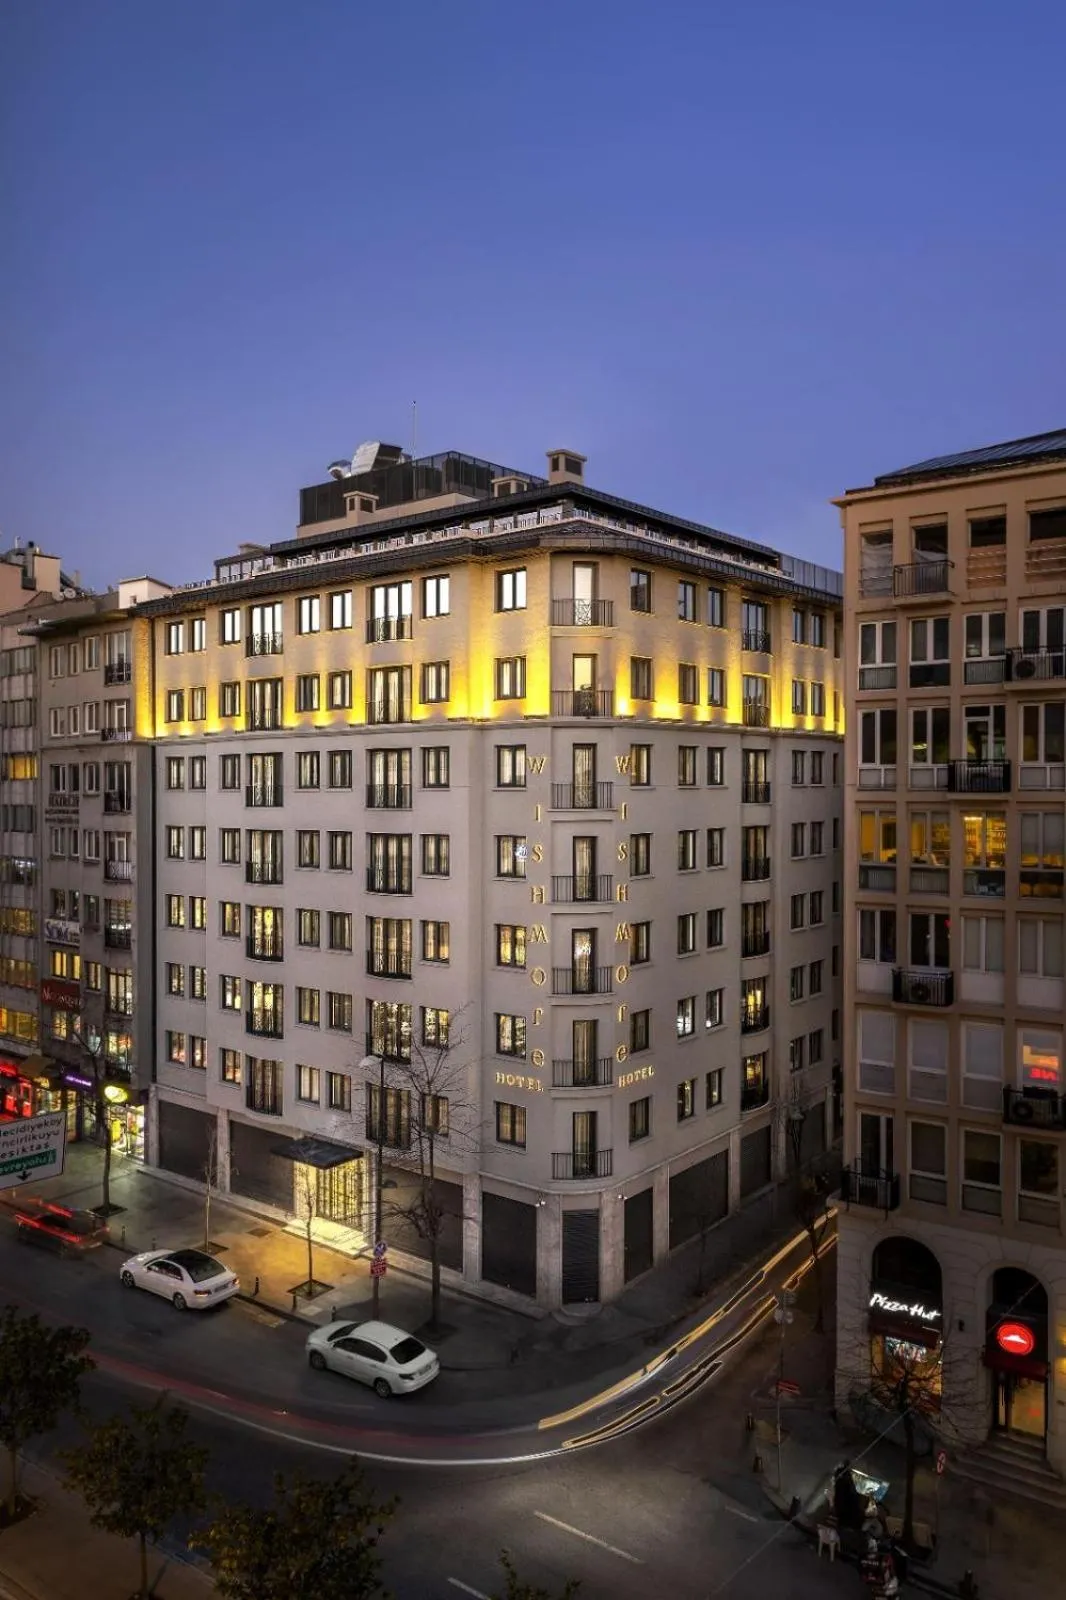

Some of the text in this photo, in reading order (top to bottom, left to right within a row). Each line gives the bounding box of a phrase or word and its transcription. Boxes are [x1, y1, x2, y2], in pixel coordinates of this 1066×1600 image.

[495, 1072, 545, 1092] HOTEL
[618, 1065, 655, 1089] HOTEL
[869, 1293, 942, 1320] Pizza Hut
